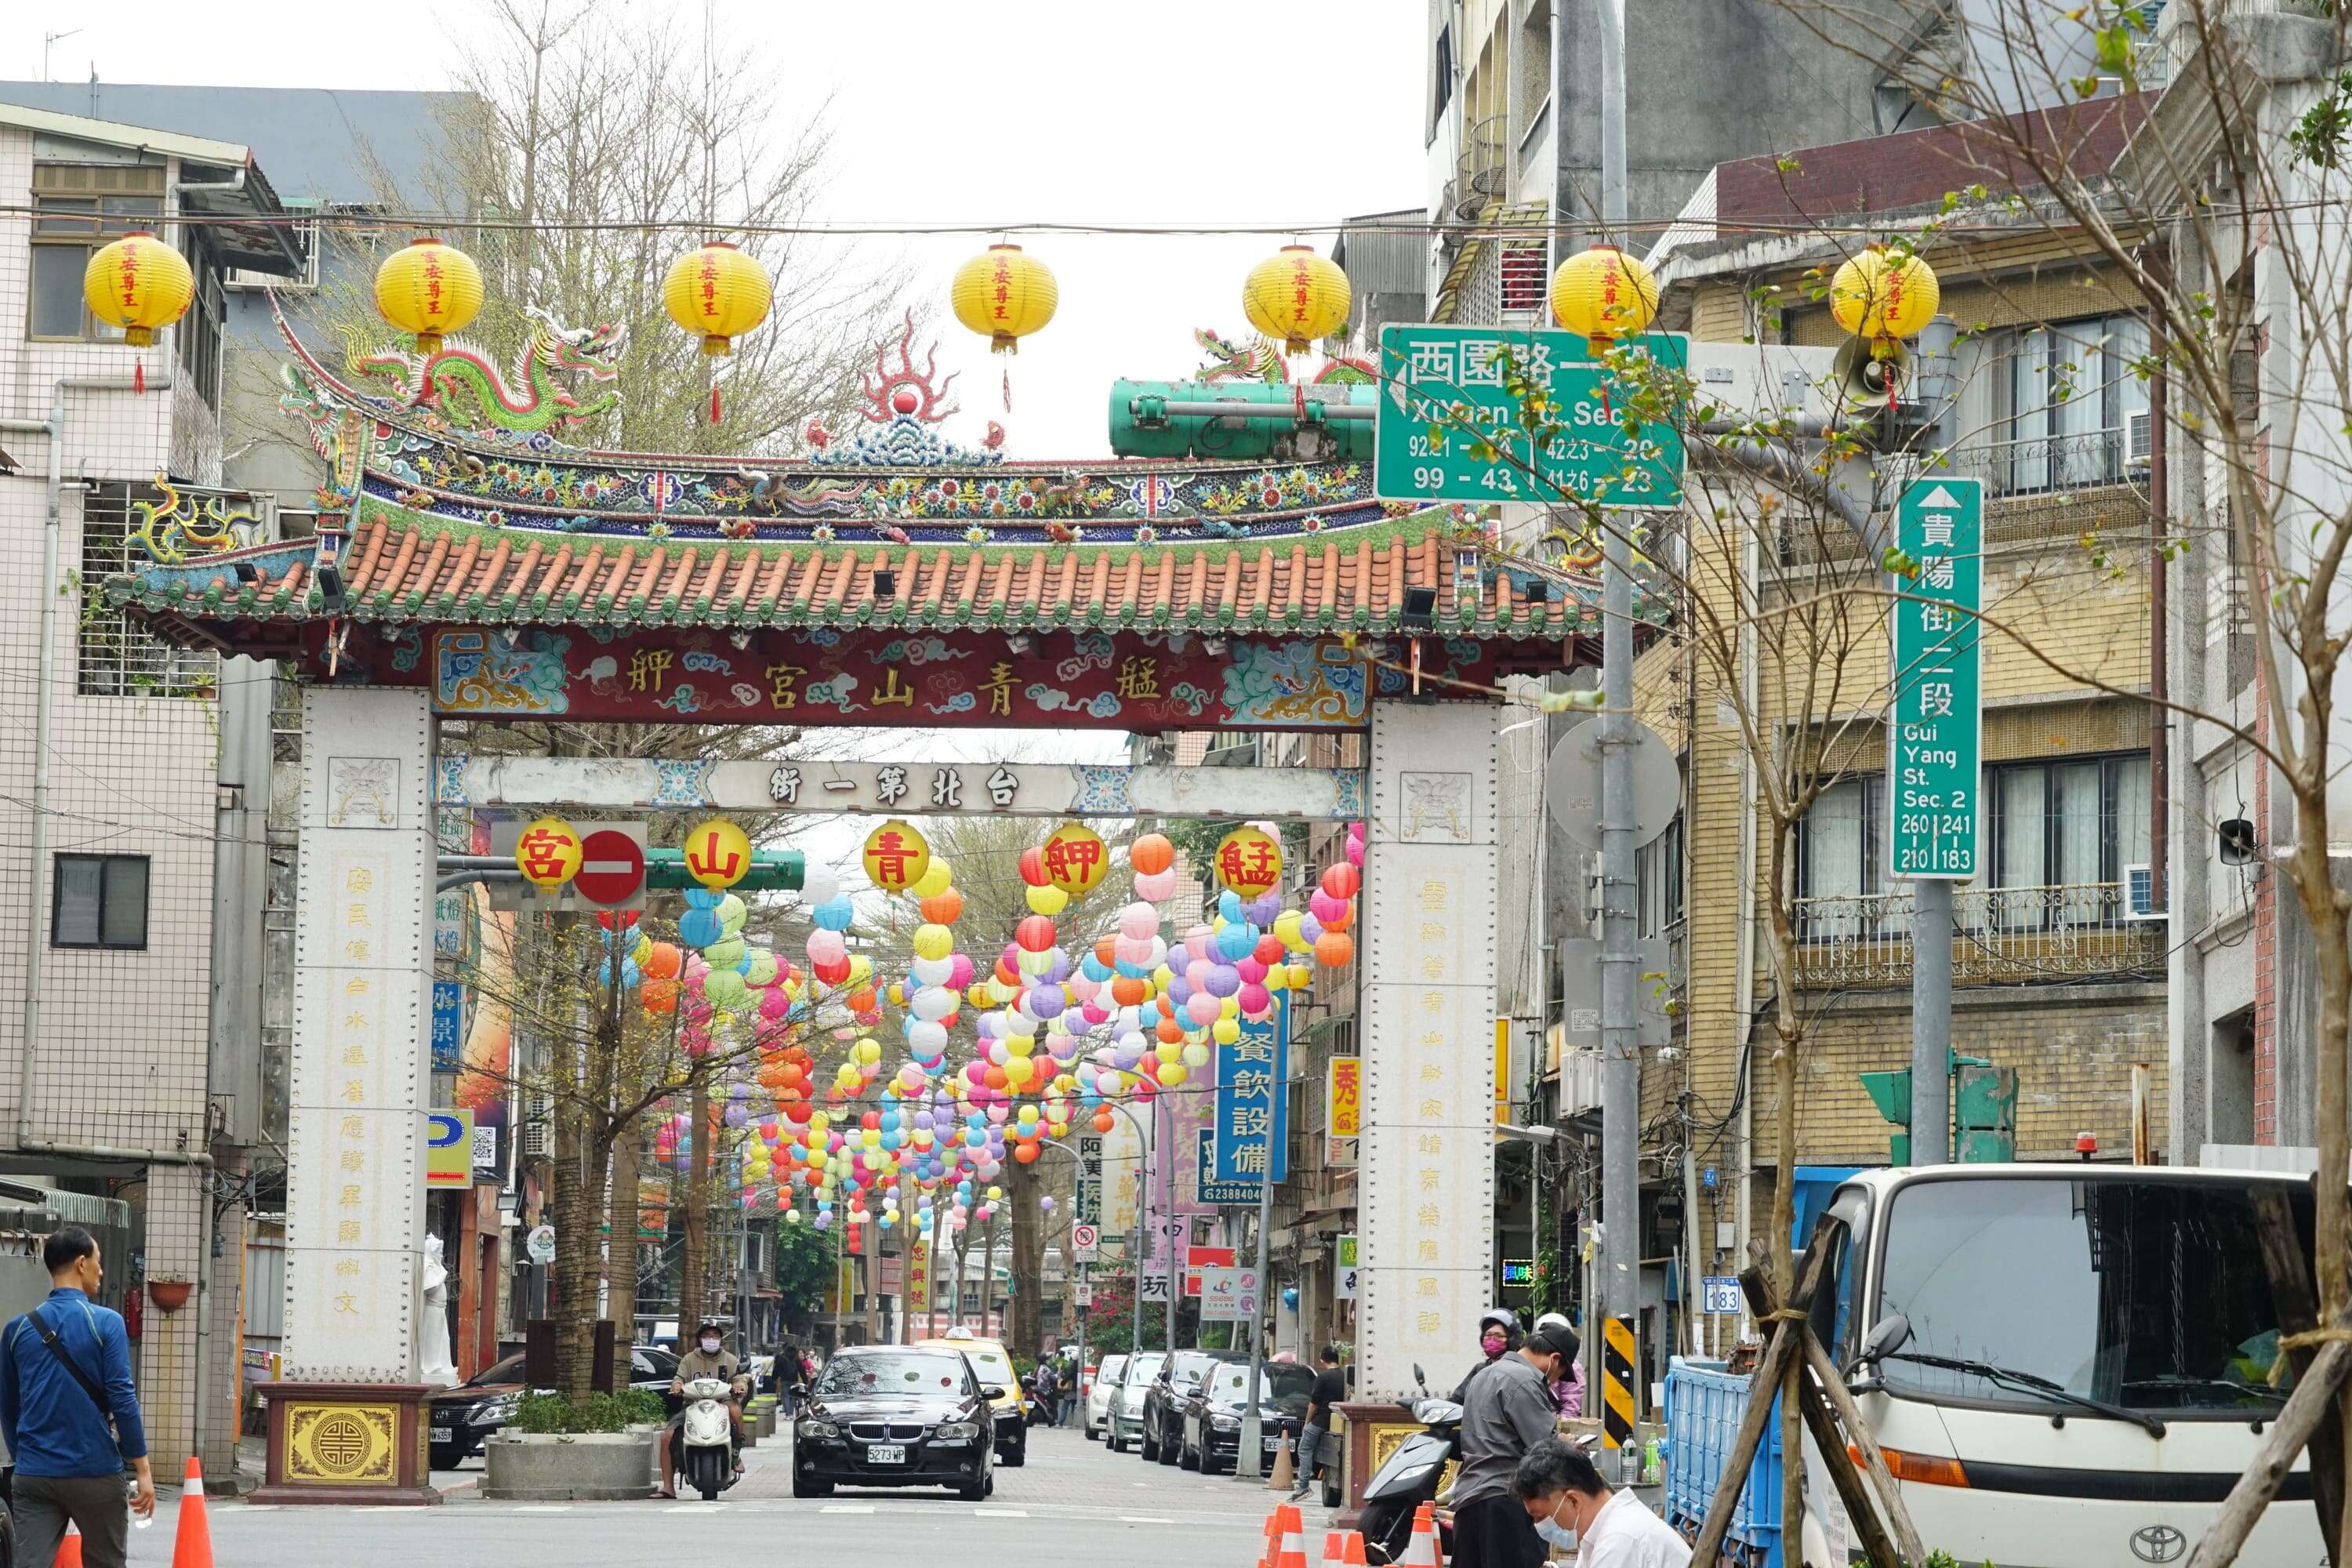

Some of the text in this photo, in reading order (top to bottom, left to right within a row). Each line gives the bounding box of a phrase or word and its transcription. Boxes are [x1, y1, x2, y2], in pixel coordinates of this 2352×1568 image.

[1414, 466, 1445, 489] 99
[1480, 468, 1513, 491] 43
[1919, 514, 1955, 717] 貴陽街二段
[1904, 724, 1937, 742] Gui
[1904, 746, 1957, 770] Yang
[1903, 768, 1929, 786] St.
[1903, 790, 1966, 808] Sec. 2
[1901, 814, 1970, 835] 260 241
[1900, 848, 1971, 869] 210 183
[1215, 1189, 1265, 1200] 2388404
